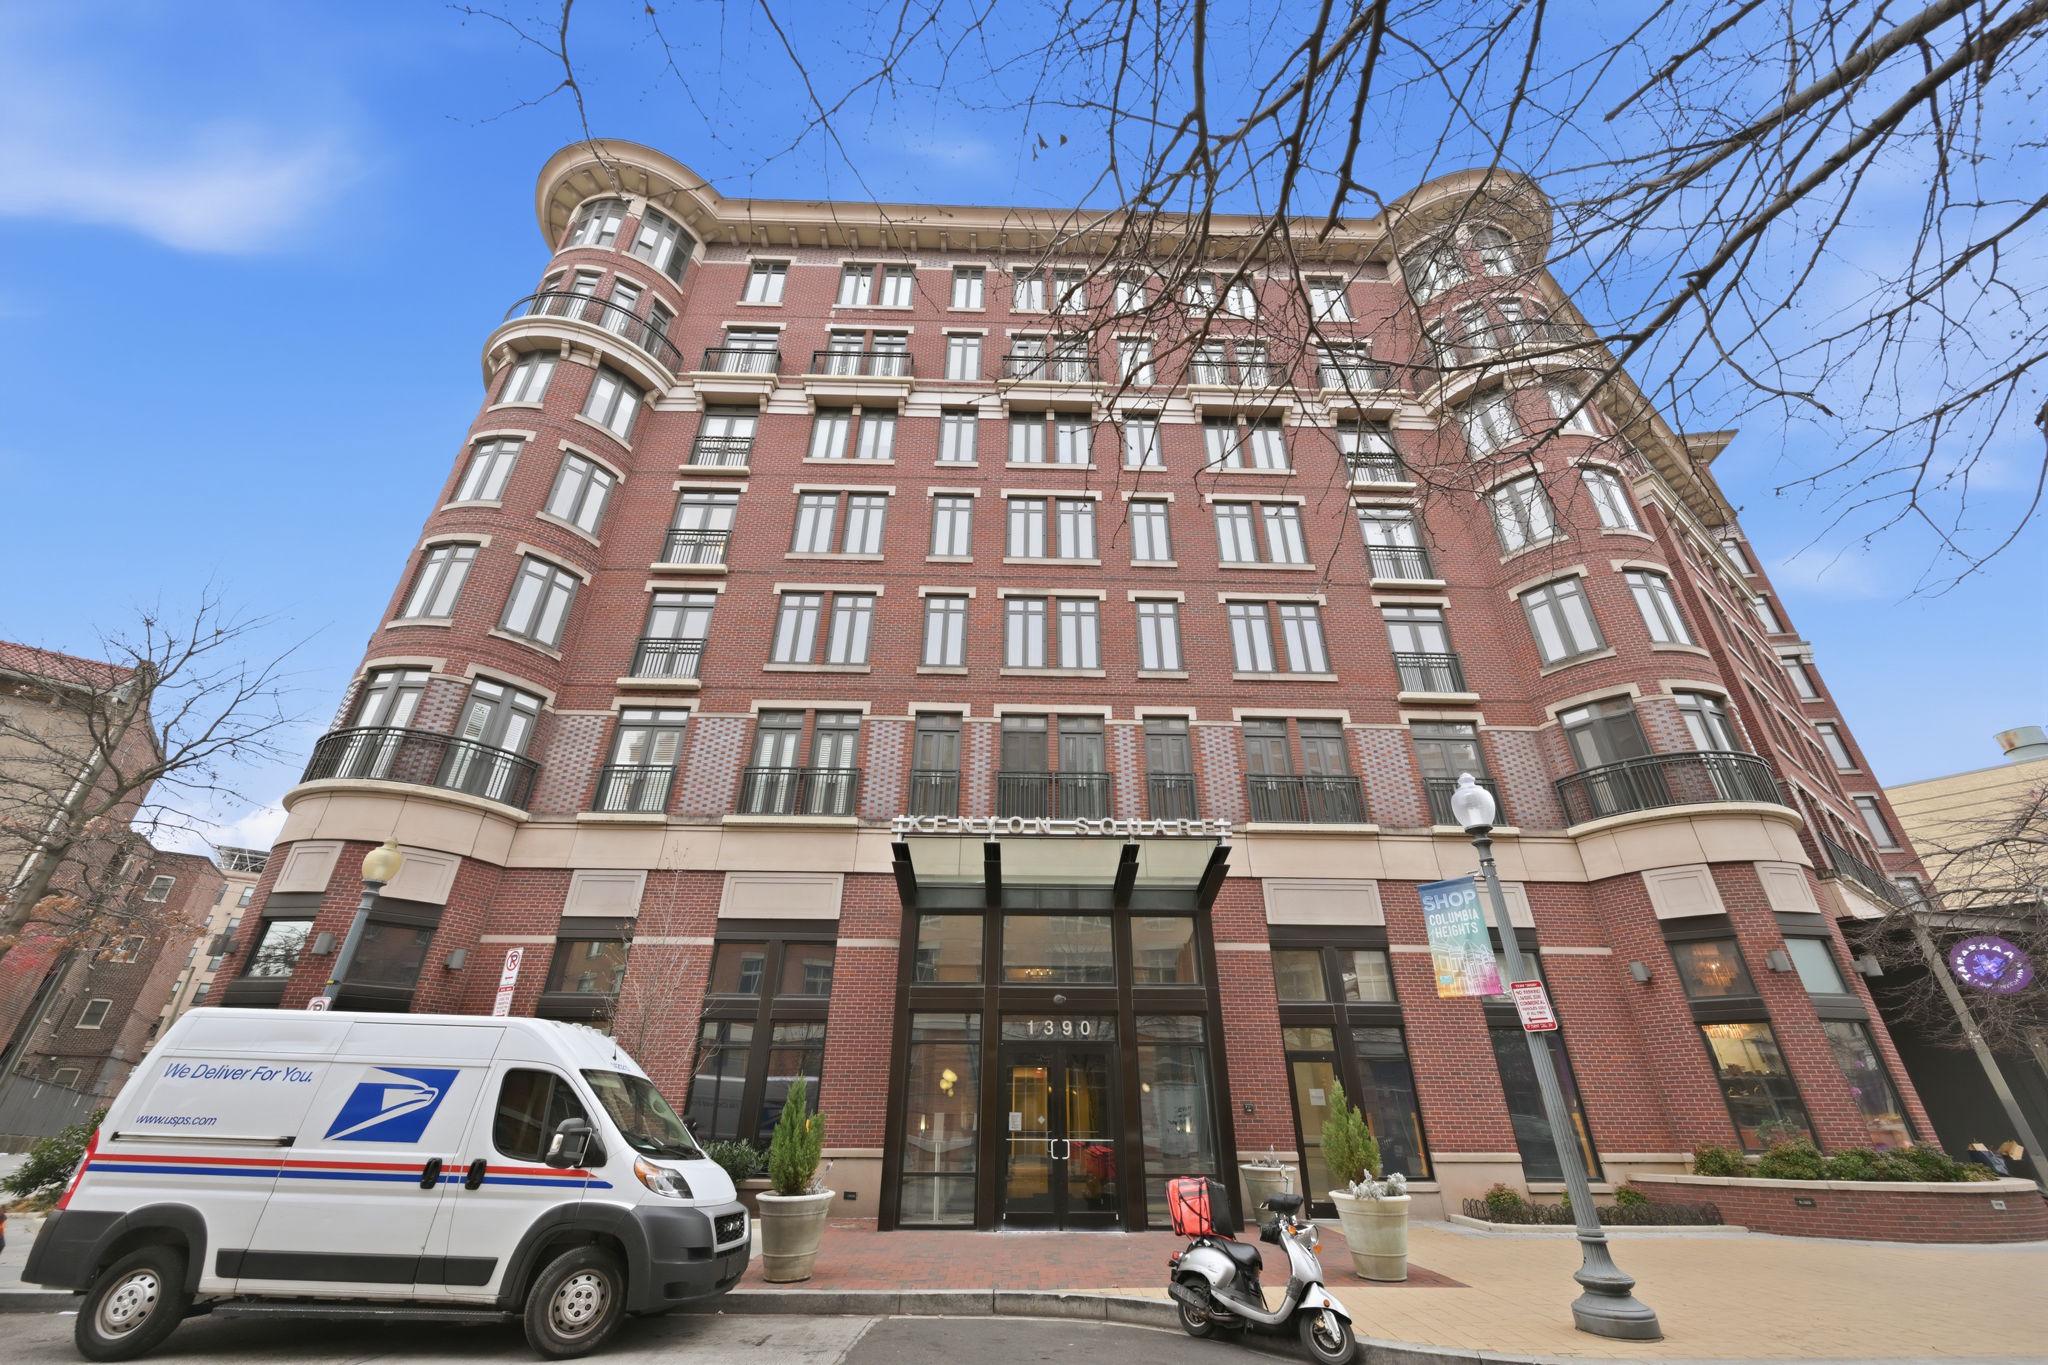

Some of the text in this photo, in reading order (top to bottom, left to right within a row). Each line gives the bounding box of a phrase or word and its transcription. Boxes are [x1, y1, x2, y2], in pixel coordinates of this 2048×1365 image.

[909, 815, 1217, 836] KENYON SQUARE
[1422, 889, 1476, 911] SHOP
[1428, 908, 1480, 926] COLUMBIA
[1434, 921, 1479, 938] HEIGHTS
[1027, 1020, 1090, 1036] 1390
[164, 1063, 314, 1082] We Deliver For You.
[136, 1112, 218, 1127] www.usps.com
